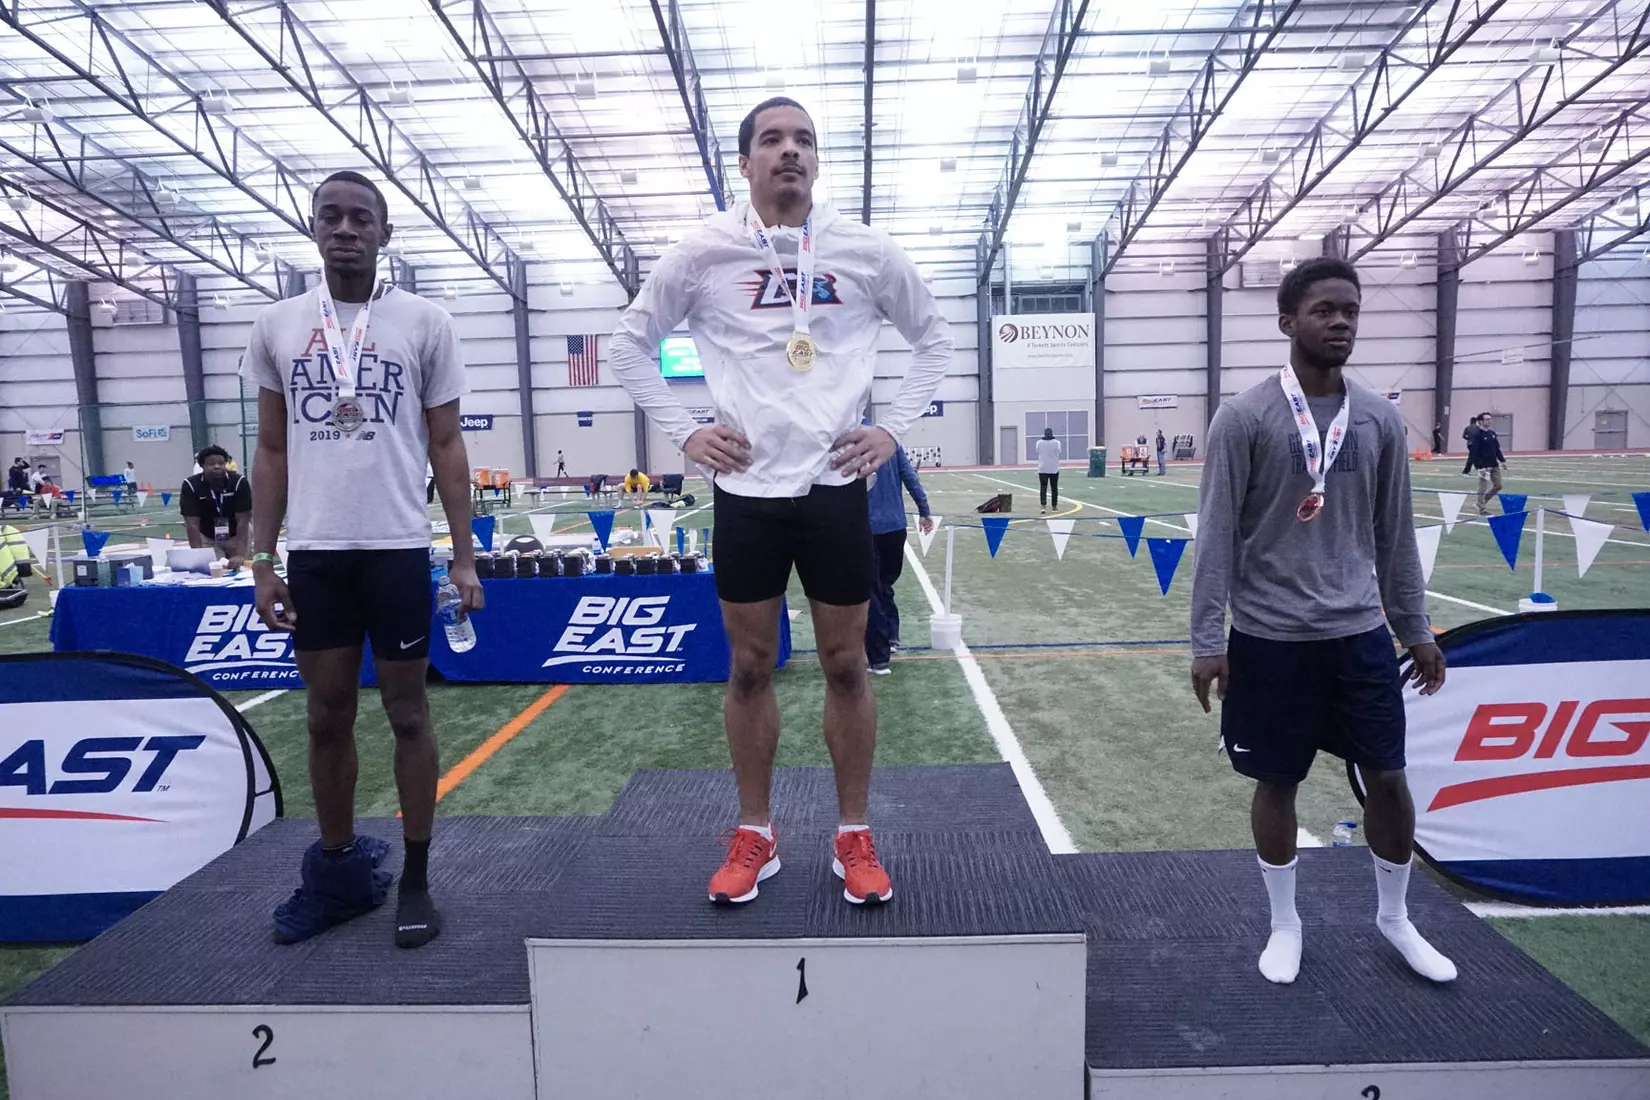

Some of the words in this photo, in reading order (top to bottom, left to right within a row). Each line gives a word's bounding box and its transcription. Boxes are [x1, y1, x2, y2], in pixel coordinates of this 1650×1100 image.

[1020, 324, 1090, 340] BEYNON
[290, 386, 404, 426] ICN
[310, 430, 340, 441] 2019
[460, 417, 488, 428] Jeep
[568, 595, 671, 626] BIG
[184, 633, 297, 662] EAS
[552, 623, 697, 654] EAST
[582, 663, 686, 675] CONFERENCE
[1453, 698, 1650, 762] BIG
[796, 957, 808, 1005] 1
[252, 1024, 276, 1069] 2
